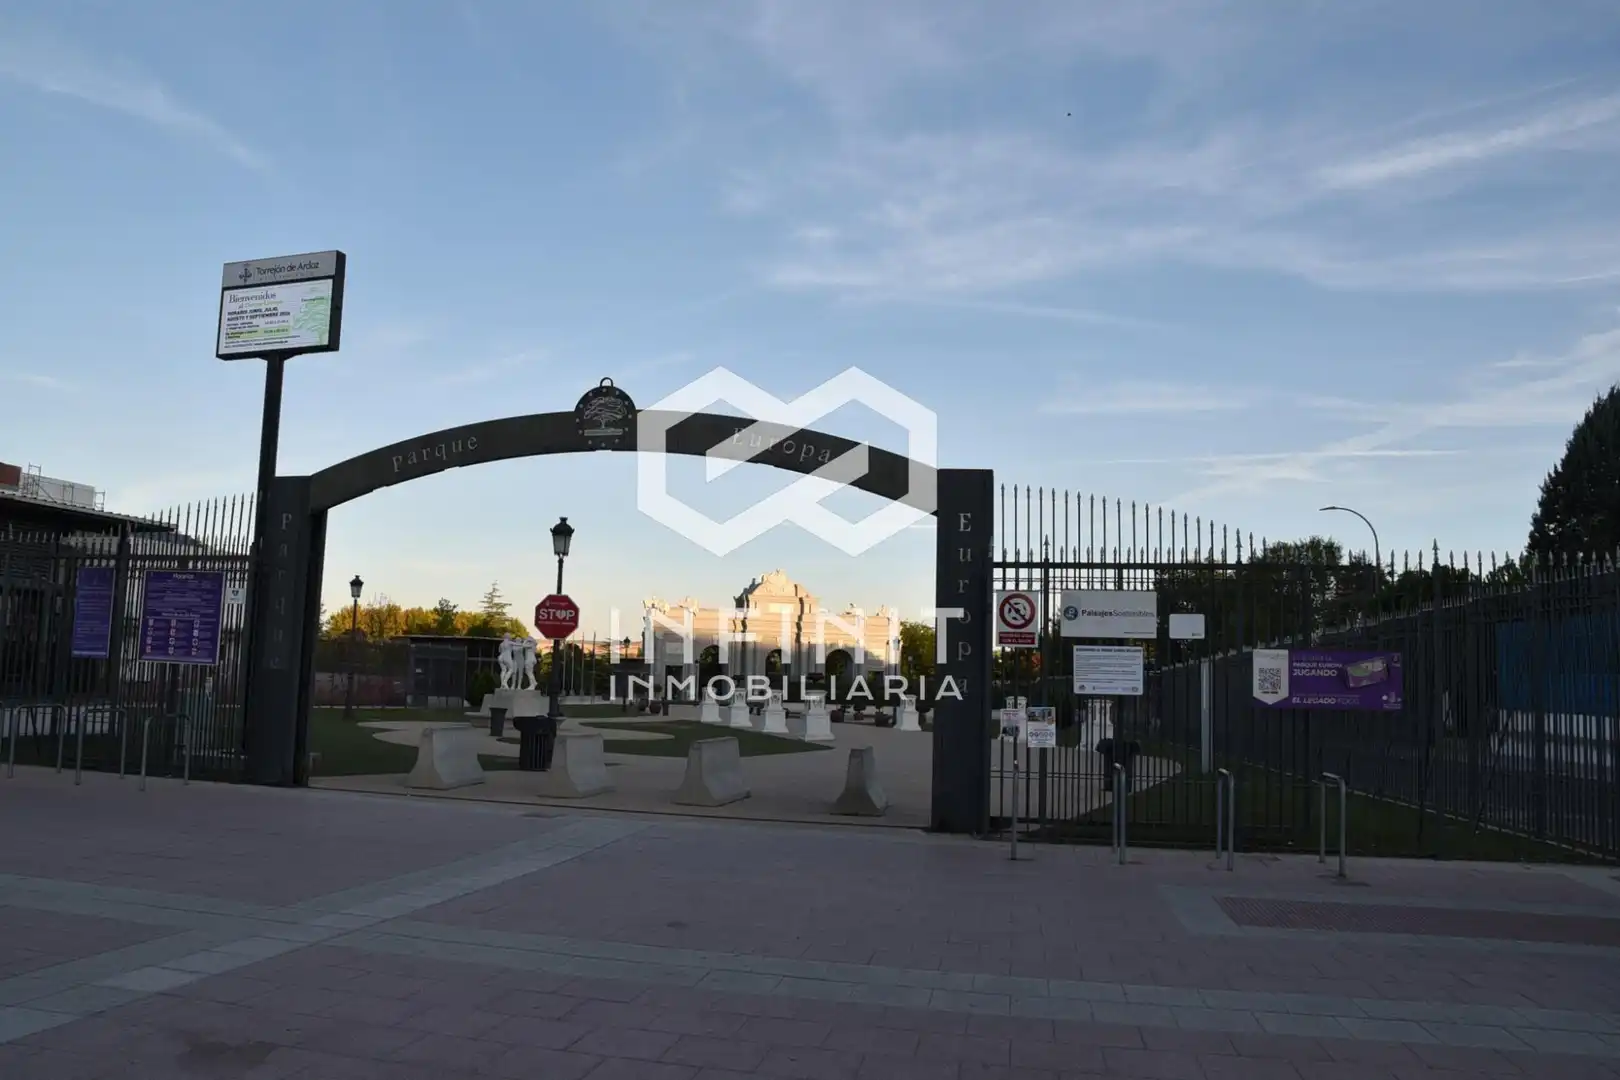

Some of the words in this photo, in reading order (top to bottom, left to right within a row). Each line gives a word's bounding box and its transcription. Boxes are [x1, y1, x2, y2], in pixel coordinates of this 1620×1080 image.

[256, 264, 285, 276] Torrejón
[287, 263, 297, 272] de
[228, 290, 277, 303] Bienvenidos
[393, 435, 479, 472] Parque
[732, 426, 831, 464] Europa
[269, 512, 292, 669] Parque
[957, 512, 972, 693] Europa
[539, 608, 575, 620] STOP
[1292, 669, 1338, 677] JUGANDO
